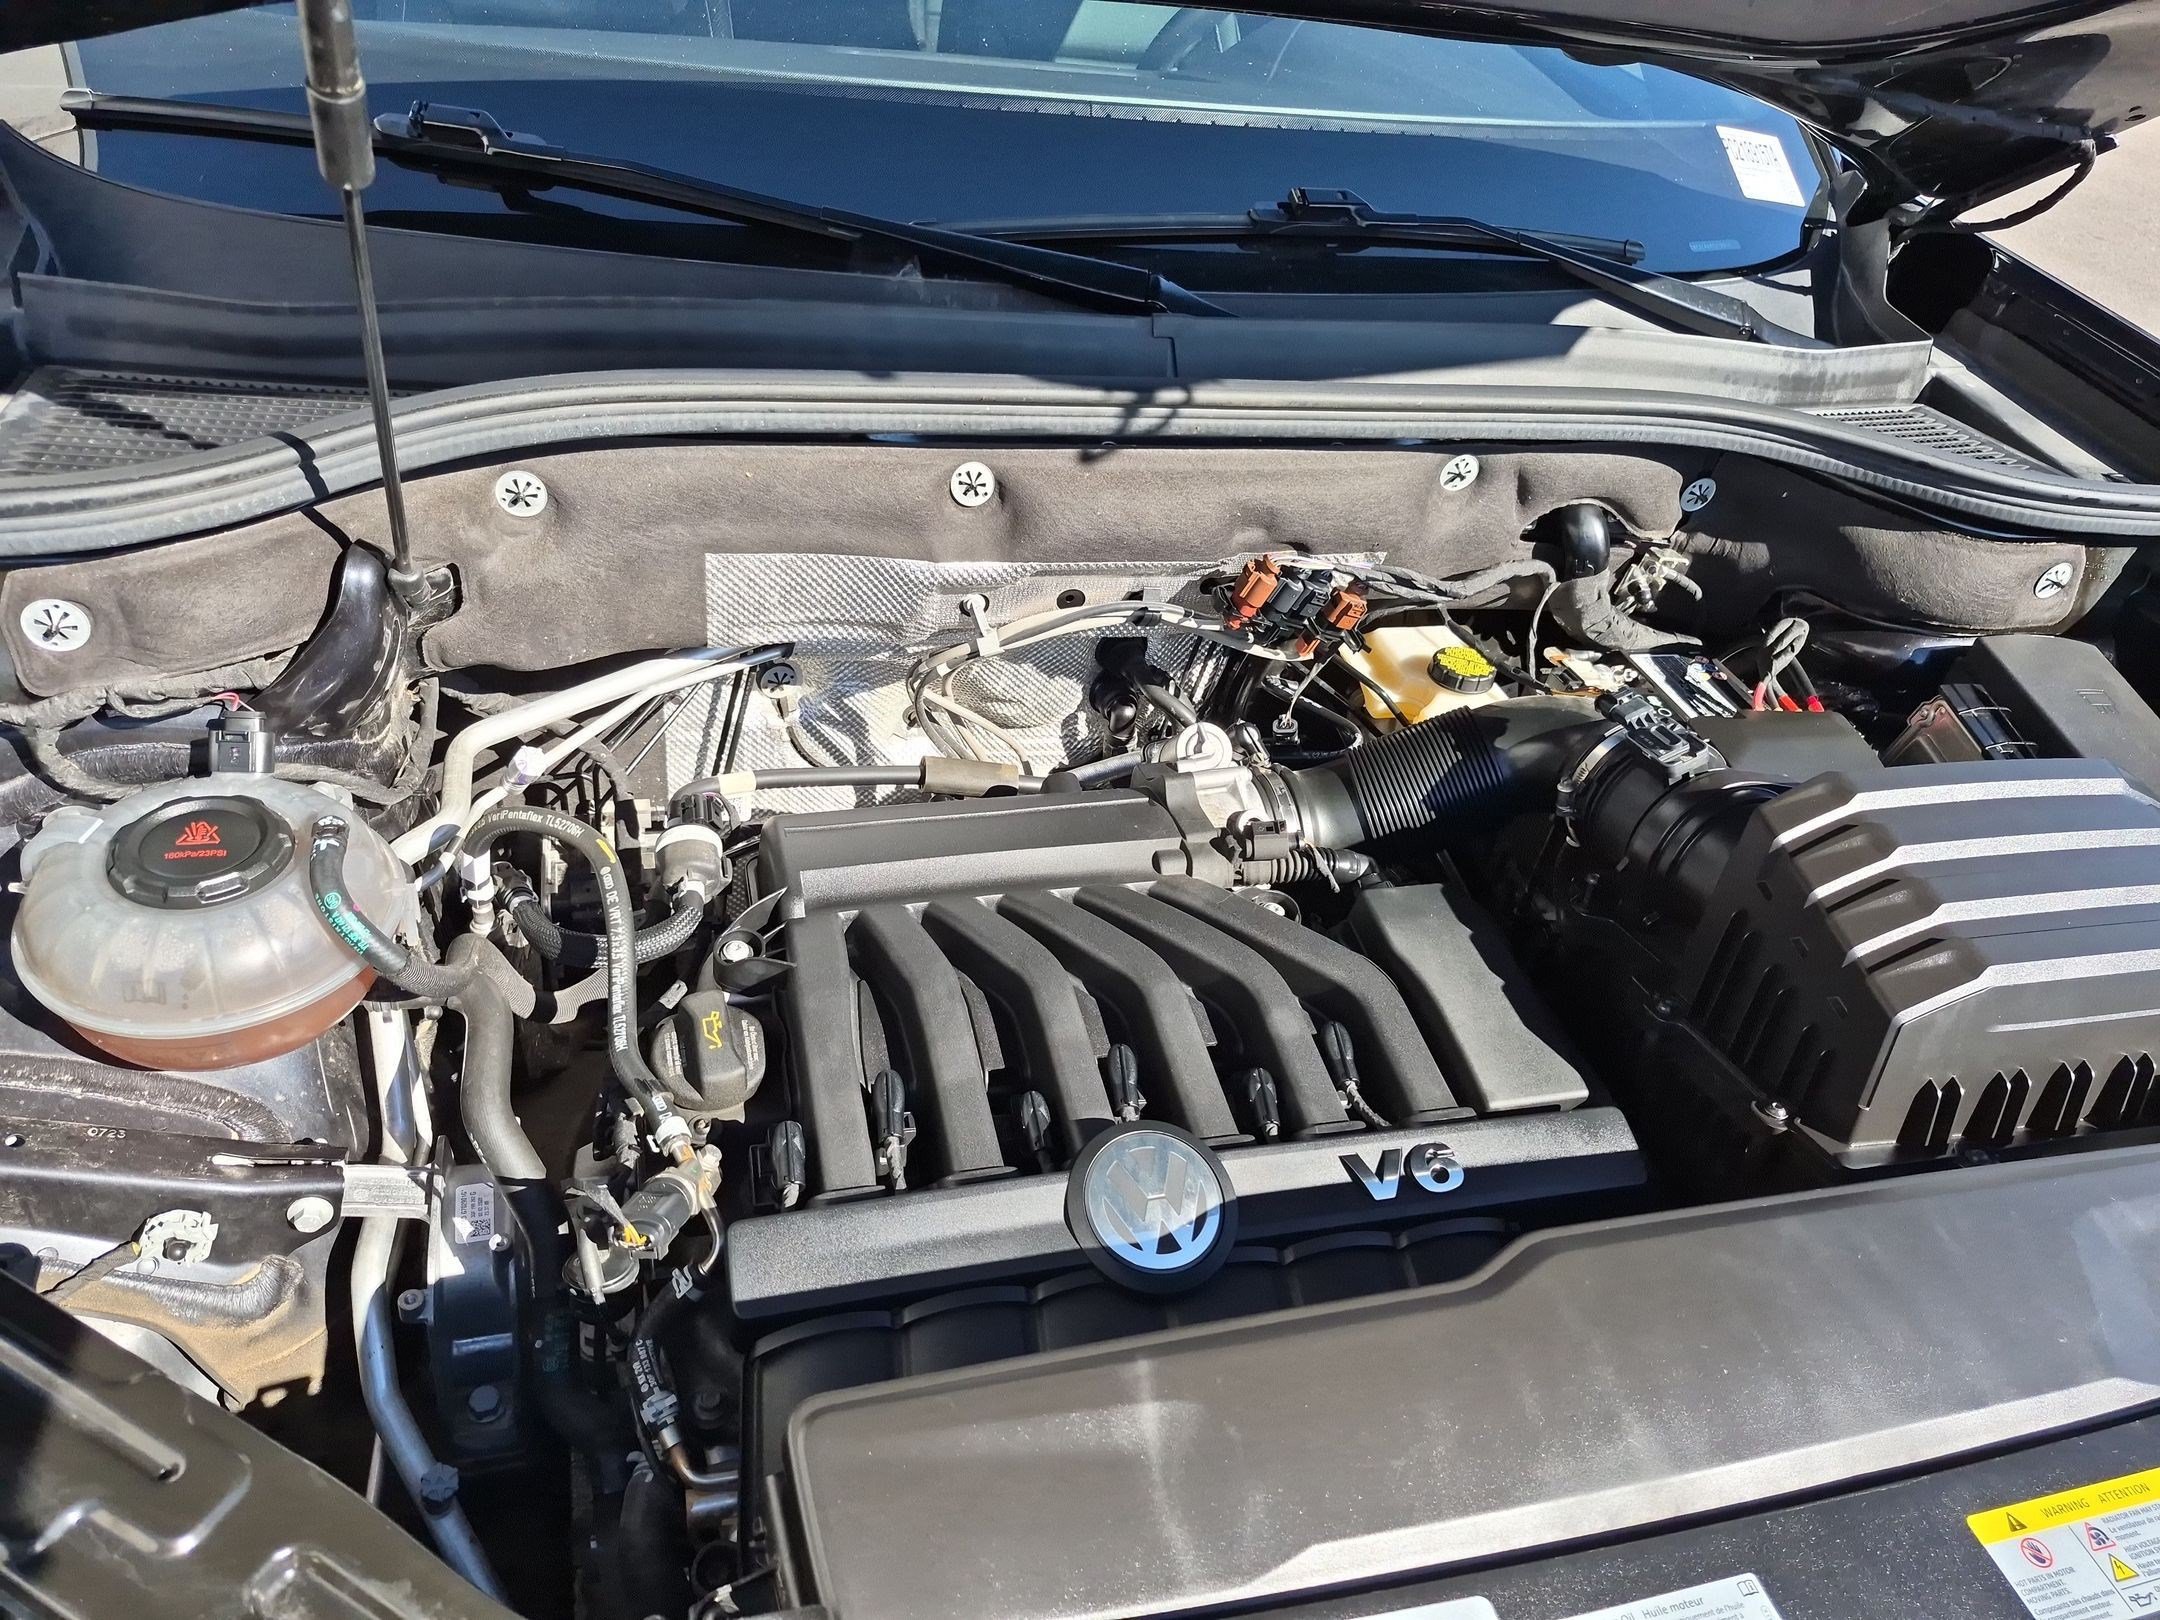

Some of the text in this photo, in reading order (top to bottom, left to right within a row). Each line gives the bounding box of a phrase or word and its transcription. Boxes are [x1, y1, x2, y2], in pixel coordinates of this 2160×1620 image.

[1338, 1142, 1465, 1201] V6
[2040, 1483, 2150, 1518] WARNING ATTENTION
[2027, 1574, 2046, 1584] PARTS
[2052, 1566, 2075, 1577] MOTOR
[1641, 1602, 1668, 1619] Huile
[1669, 1597, 1704, 1612] moteur
